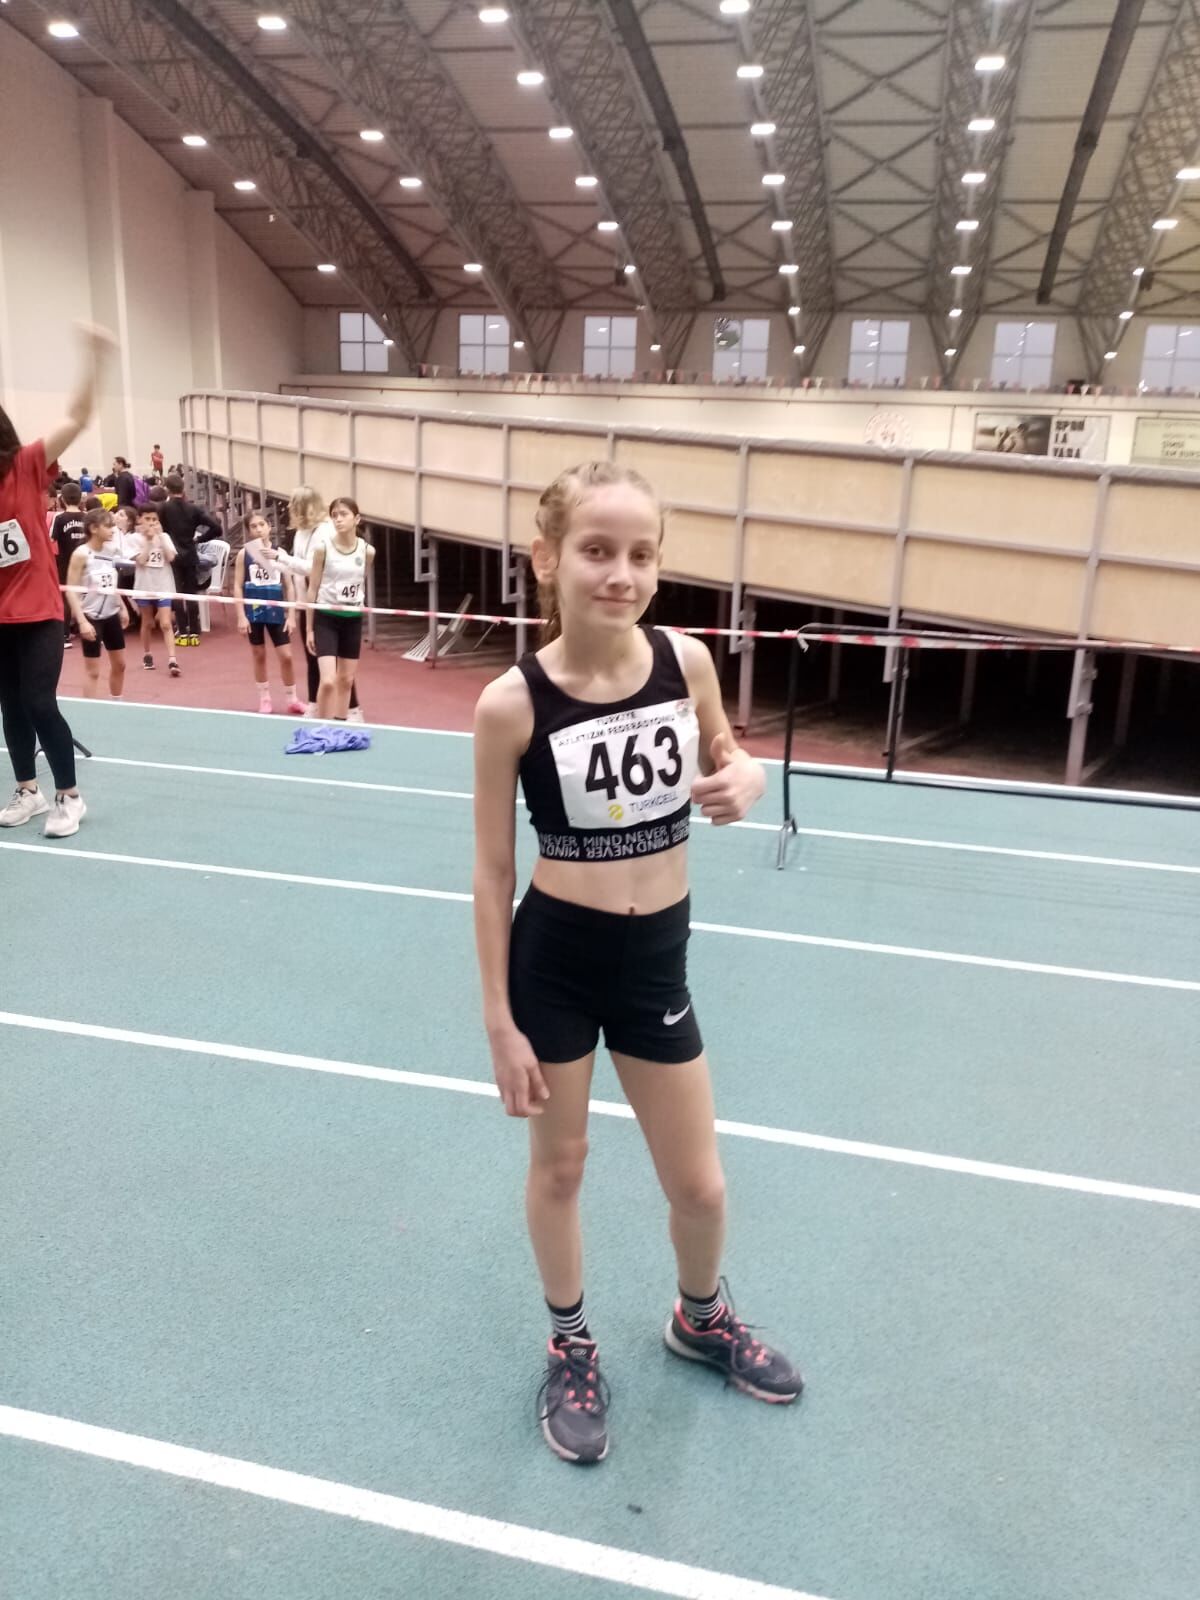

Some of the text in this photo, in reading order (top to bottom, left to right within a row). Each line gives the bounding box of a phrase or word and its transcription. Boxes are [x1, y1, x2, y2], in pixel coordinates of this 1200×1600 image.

[585, 725, 683, 801] 463
[629, 795, 678, 812] TURKCELL
[583, 833, 623, 848] MIND
[625, 825, 668, 844] NEVER
